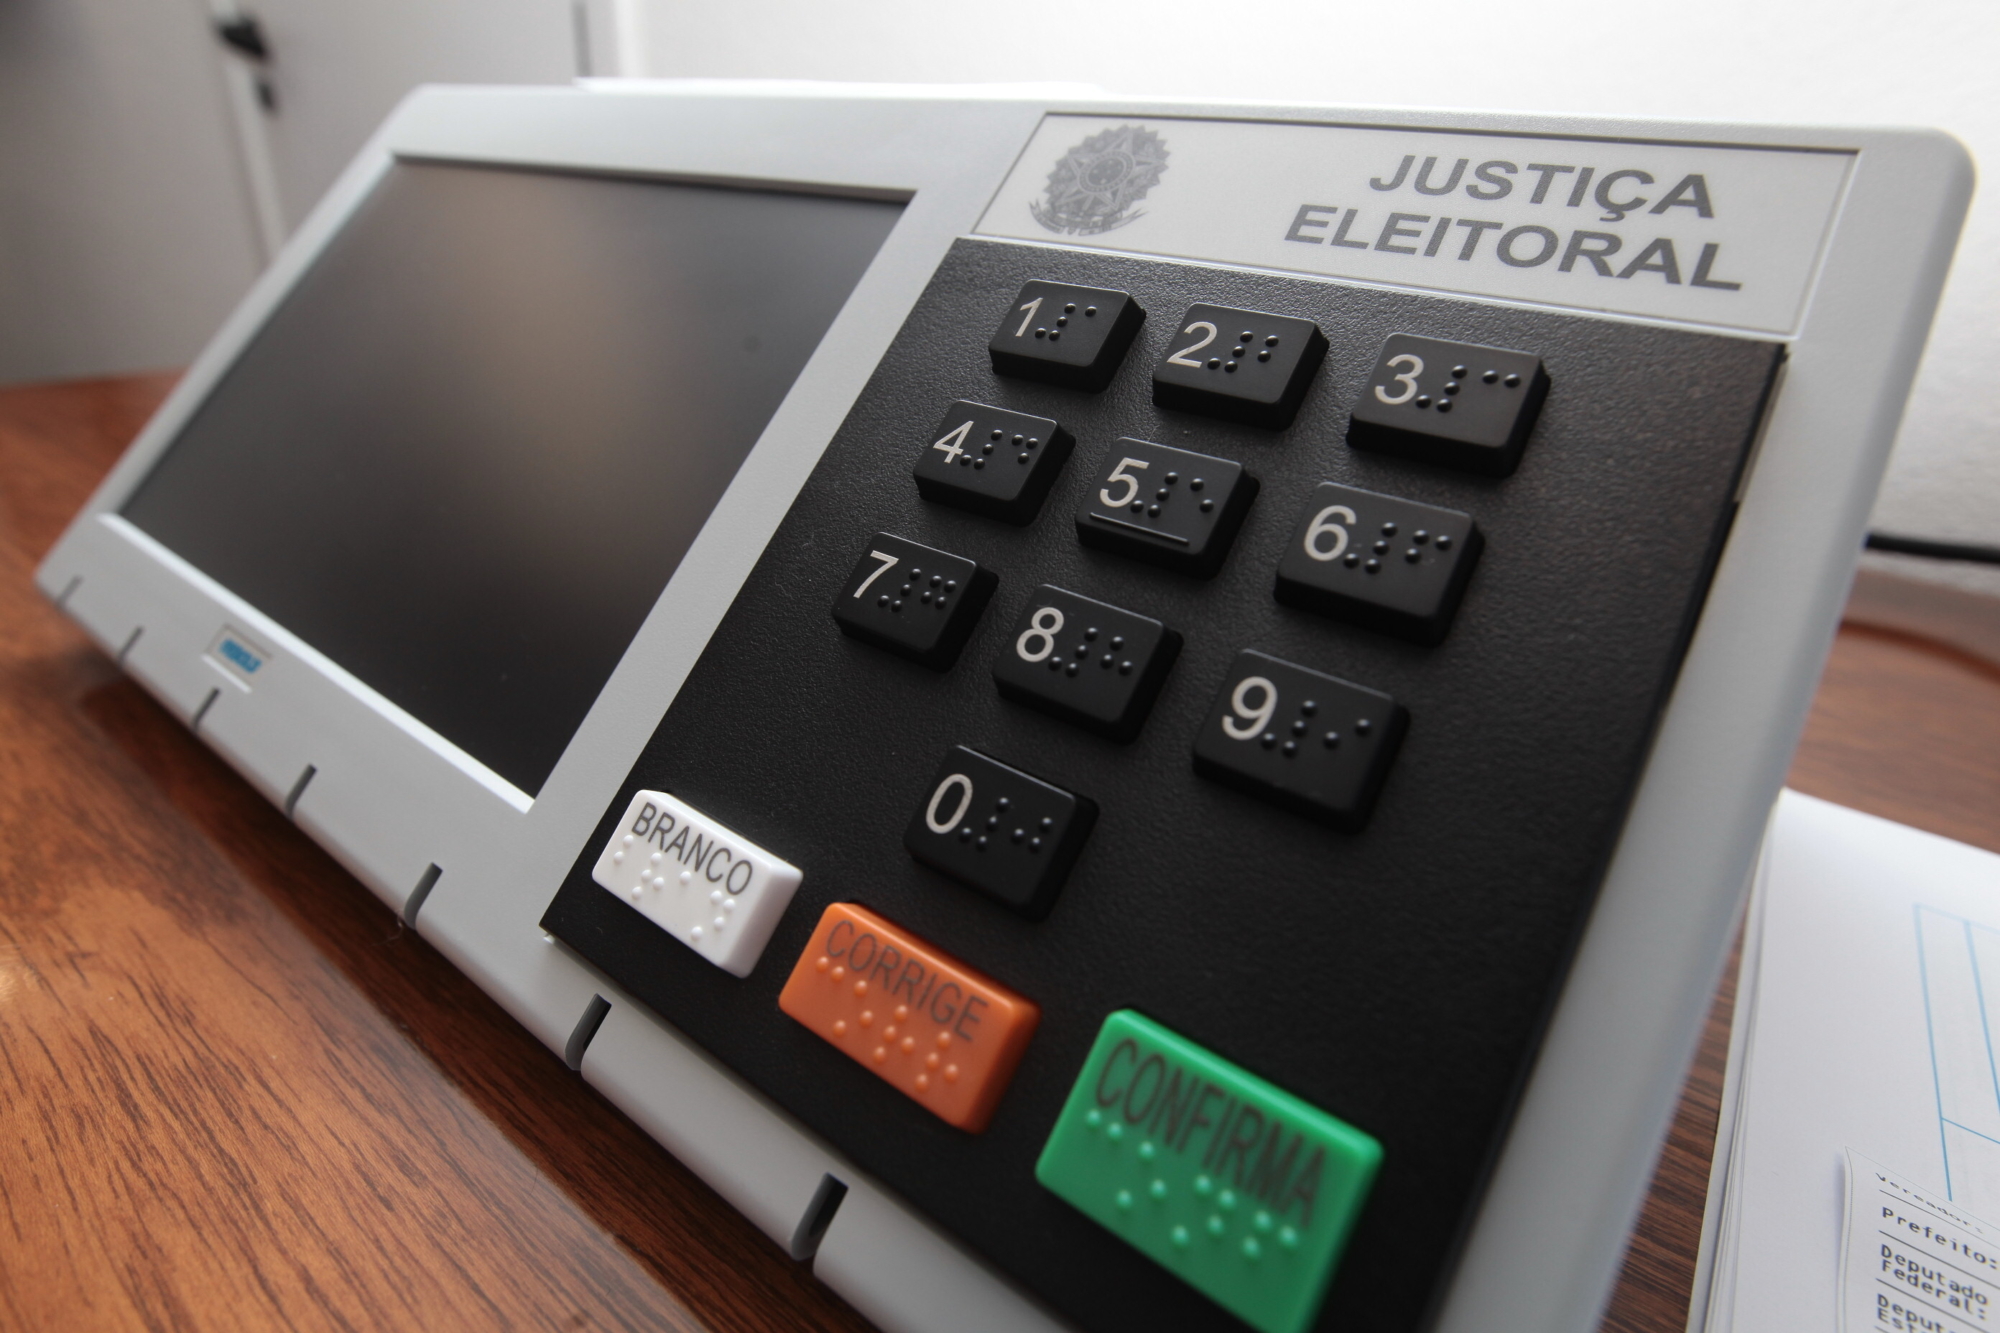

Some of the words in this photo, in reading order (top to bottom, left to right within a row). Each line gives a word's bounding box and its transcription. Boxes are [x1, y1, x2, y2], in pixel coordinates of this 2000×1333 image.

[1369, 155, 1715, 222] JUSTIÇA
[1284, 204, 1743, 291] ELEITORAL
[1015, 297, 1043, 337] 1
[1166, 321, 1217, 368] 2
[1374, 354, 1424, 404] 3
[932, 420, 974, 463] 4
[1100, 457, 1149, 508] 5
[1304, 505, 1356, 561] 6
[853, 550, 899, 599] 7
[1016, 607, 1064, 662] 8
[1222, 676, 1278, 740] 9
[926, 774, 973, 834] 0
[630, 802, 753, 896] BRANCO
[826, 919, 989, 1042] CORRIGE
[1096, 1038, 1327, 1230] CONFIRMA
[1882, 1206, 1998, 1270] Prefeito:
[1881, 1244, 1988, 1305] Deputado
[1882, 1259, 1986, 1321] Federal:
[1877, 1293, 1956, 1333] Deput
